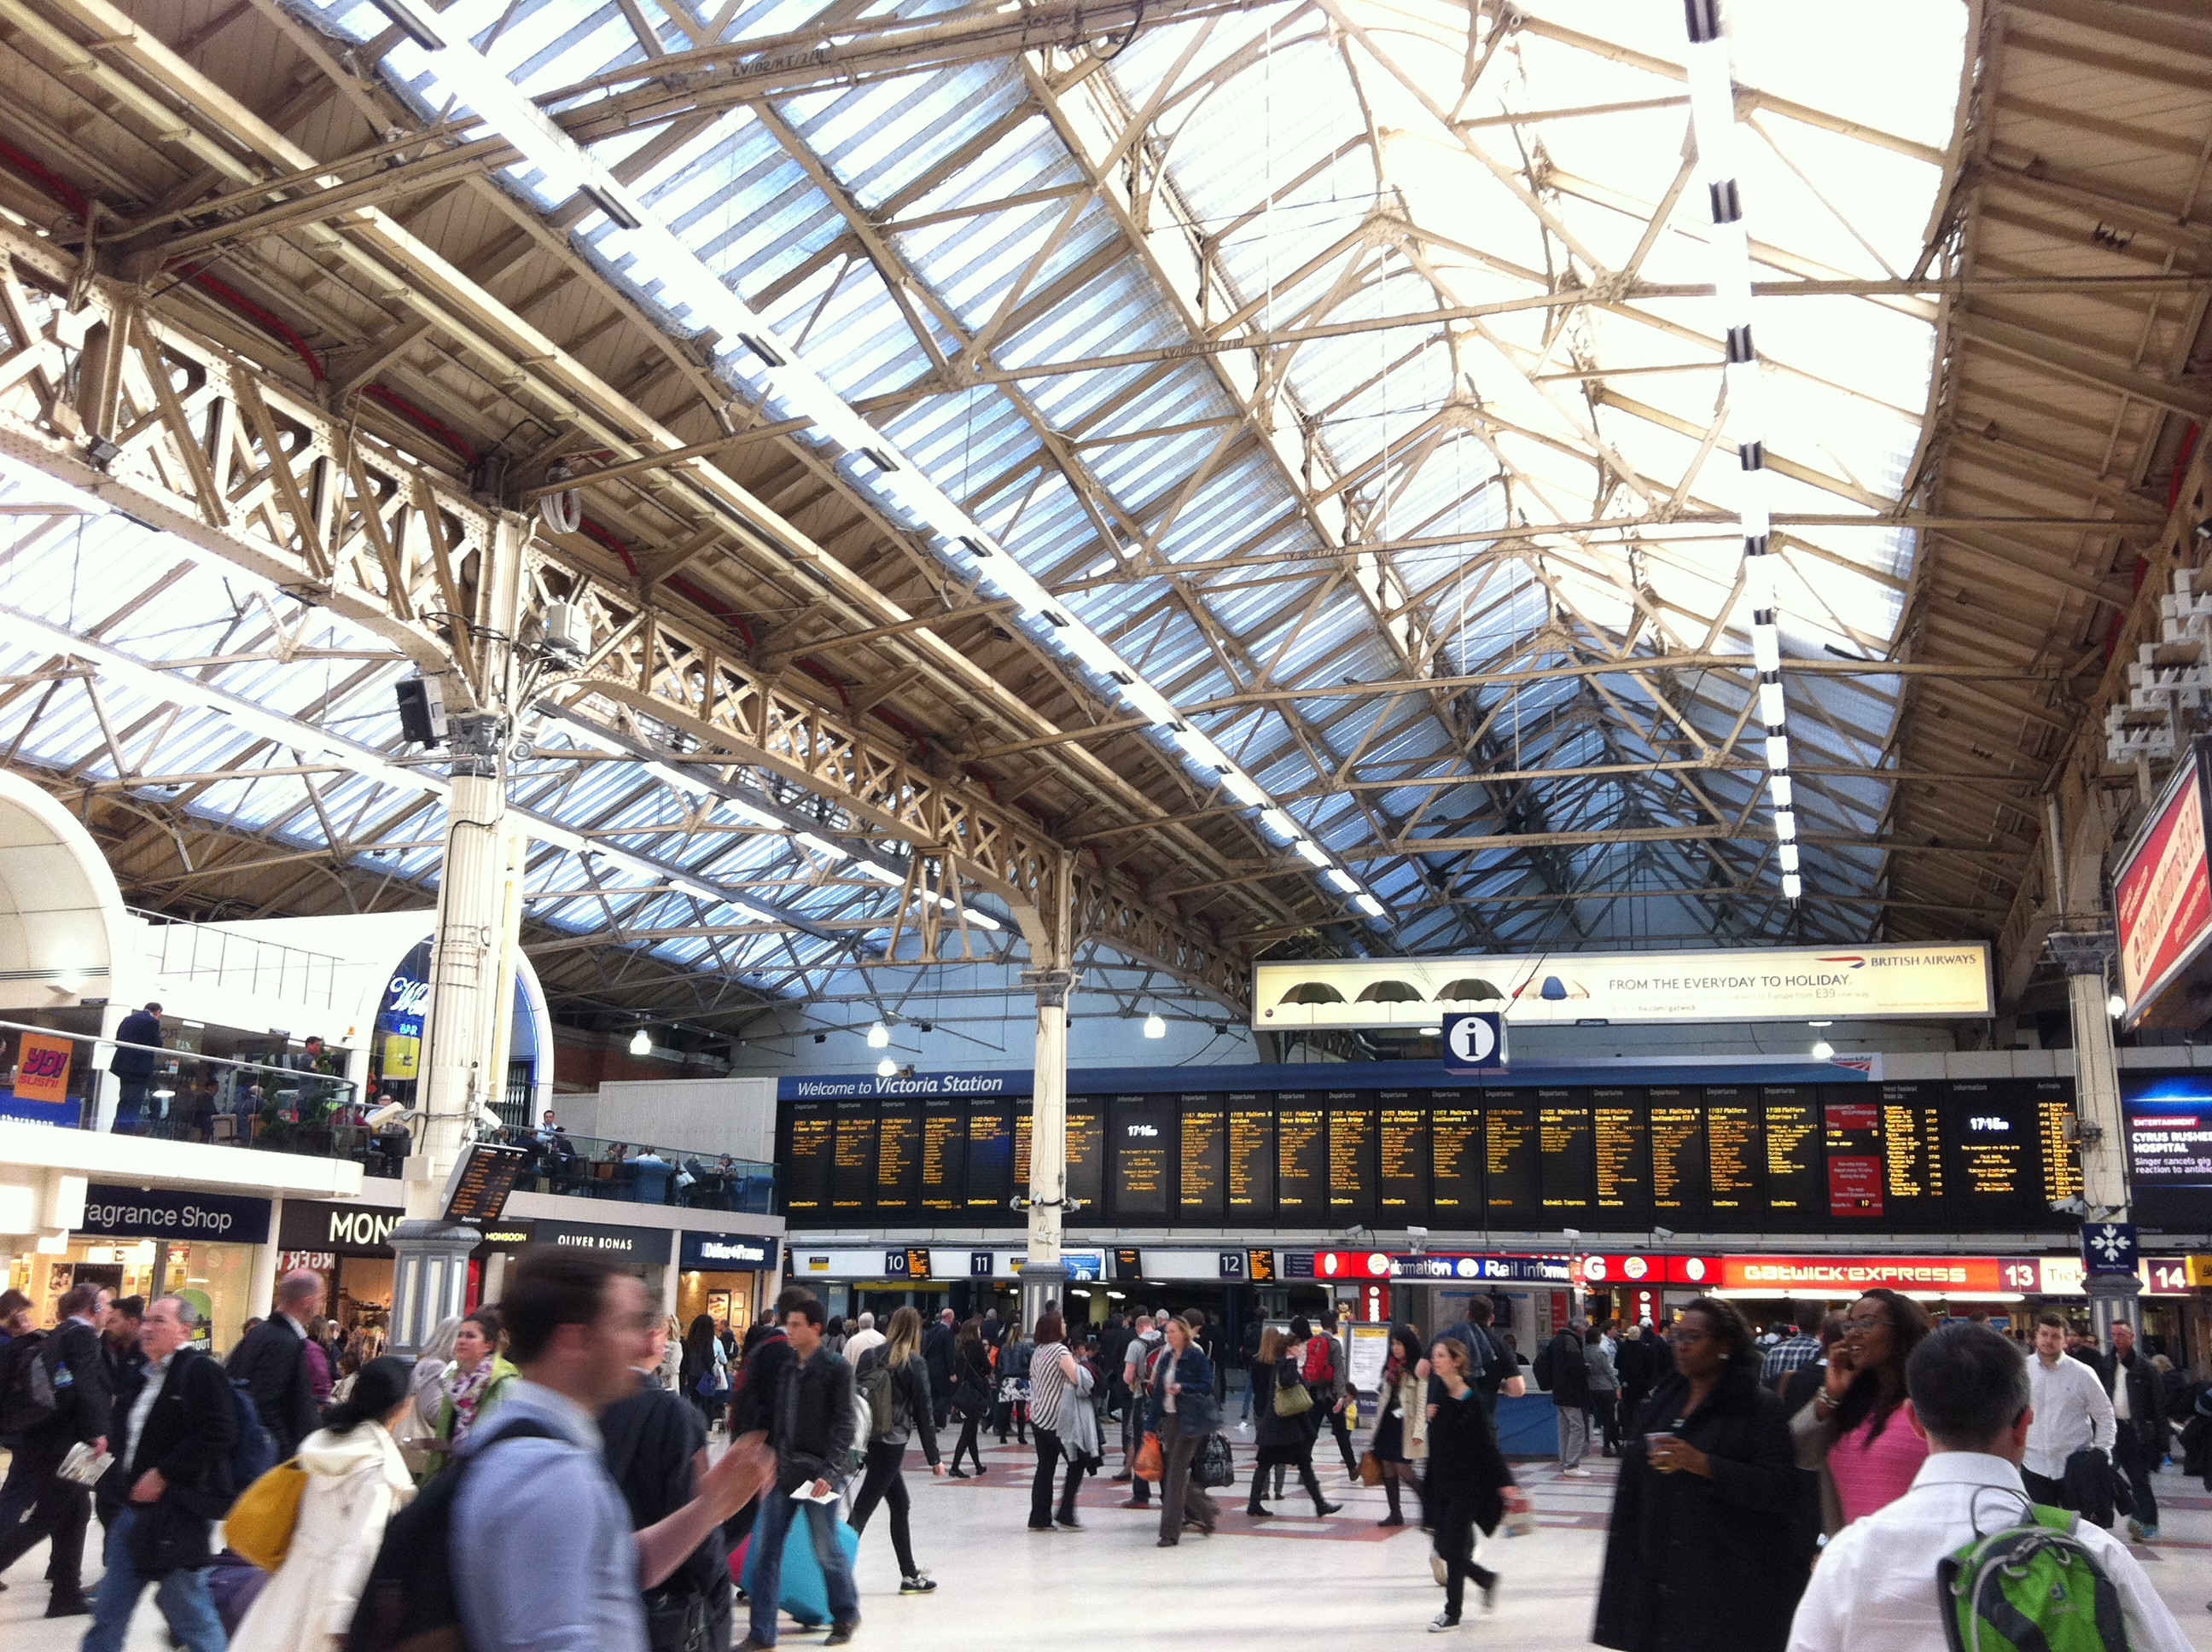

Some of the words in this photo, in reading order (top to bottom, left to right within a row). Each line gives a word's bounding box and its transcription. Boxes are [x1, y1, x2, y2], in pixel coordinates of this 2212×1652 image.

[1871, 957, 1919, 967] BRITISH
[1923, 954, 1976, 965] AIRWAYS
[1610, 980, 1648, 990] FROM
[1653, 979, 1679, 989] THE
[1685, 977, 1756, 988] EVERYDAY
[1761, 975, 1781, 986] TO
[1815, 989, 1836, 998] £39
[21, 1047, 69, 1079] YO!
[798, 1082, 854, 1096] Welcome
[859, 1081, 871, 1095] to
[875, 1076, 938, 1094] Victoria
[942, 1075, 1003, 1093] Station
[2133, 1132, 2168, 1142] CYRUS
[2133, 1143, 2188, 1153] HOSPITAL
[2135, 1158, 2162, 1167] Singer
[2164, 1157, 2196, 1166] cancels
[182, 1206, 232, 1234] Shop
[329, 1212, 407, 1245] MON
[486, 1232, 527, 1242] MONSOON
[558, 1235, 594, 1248] OLIVER
[599, 1237, 632, 1251] BONAS
[888, 1254, 905, 1271] 10
[975, 1256, 988, 1272] 11
[1222, 1256, 1240, 1271] 12
[1485, 1259, 1518, 1277] Rail
[2005, 1265, 2034, 1287] 13
[2156, 1267, 2186, 1288] 14
